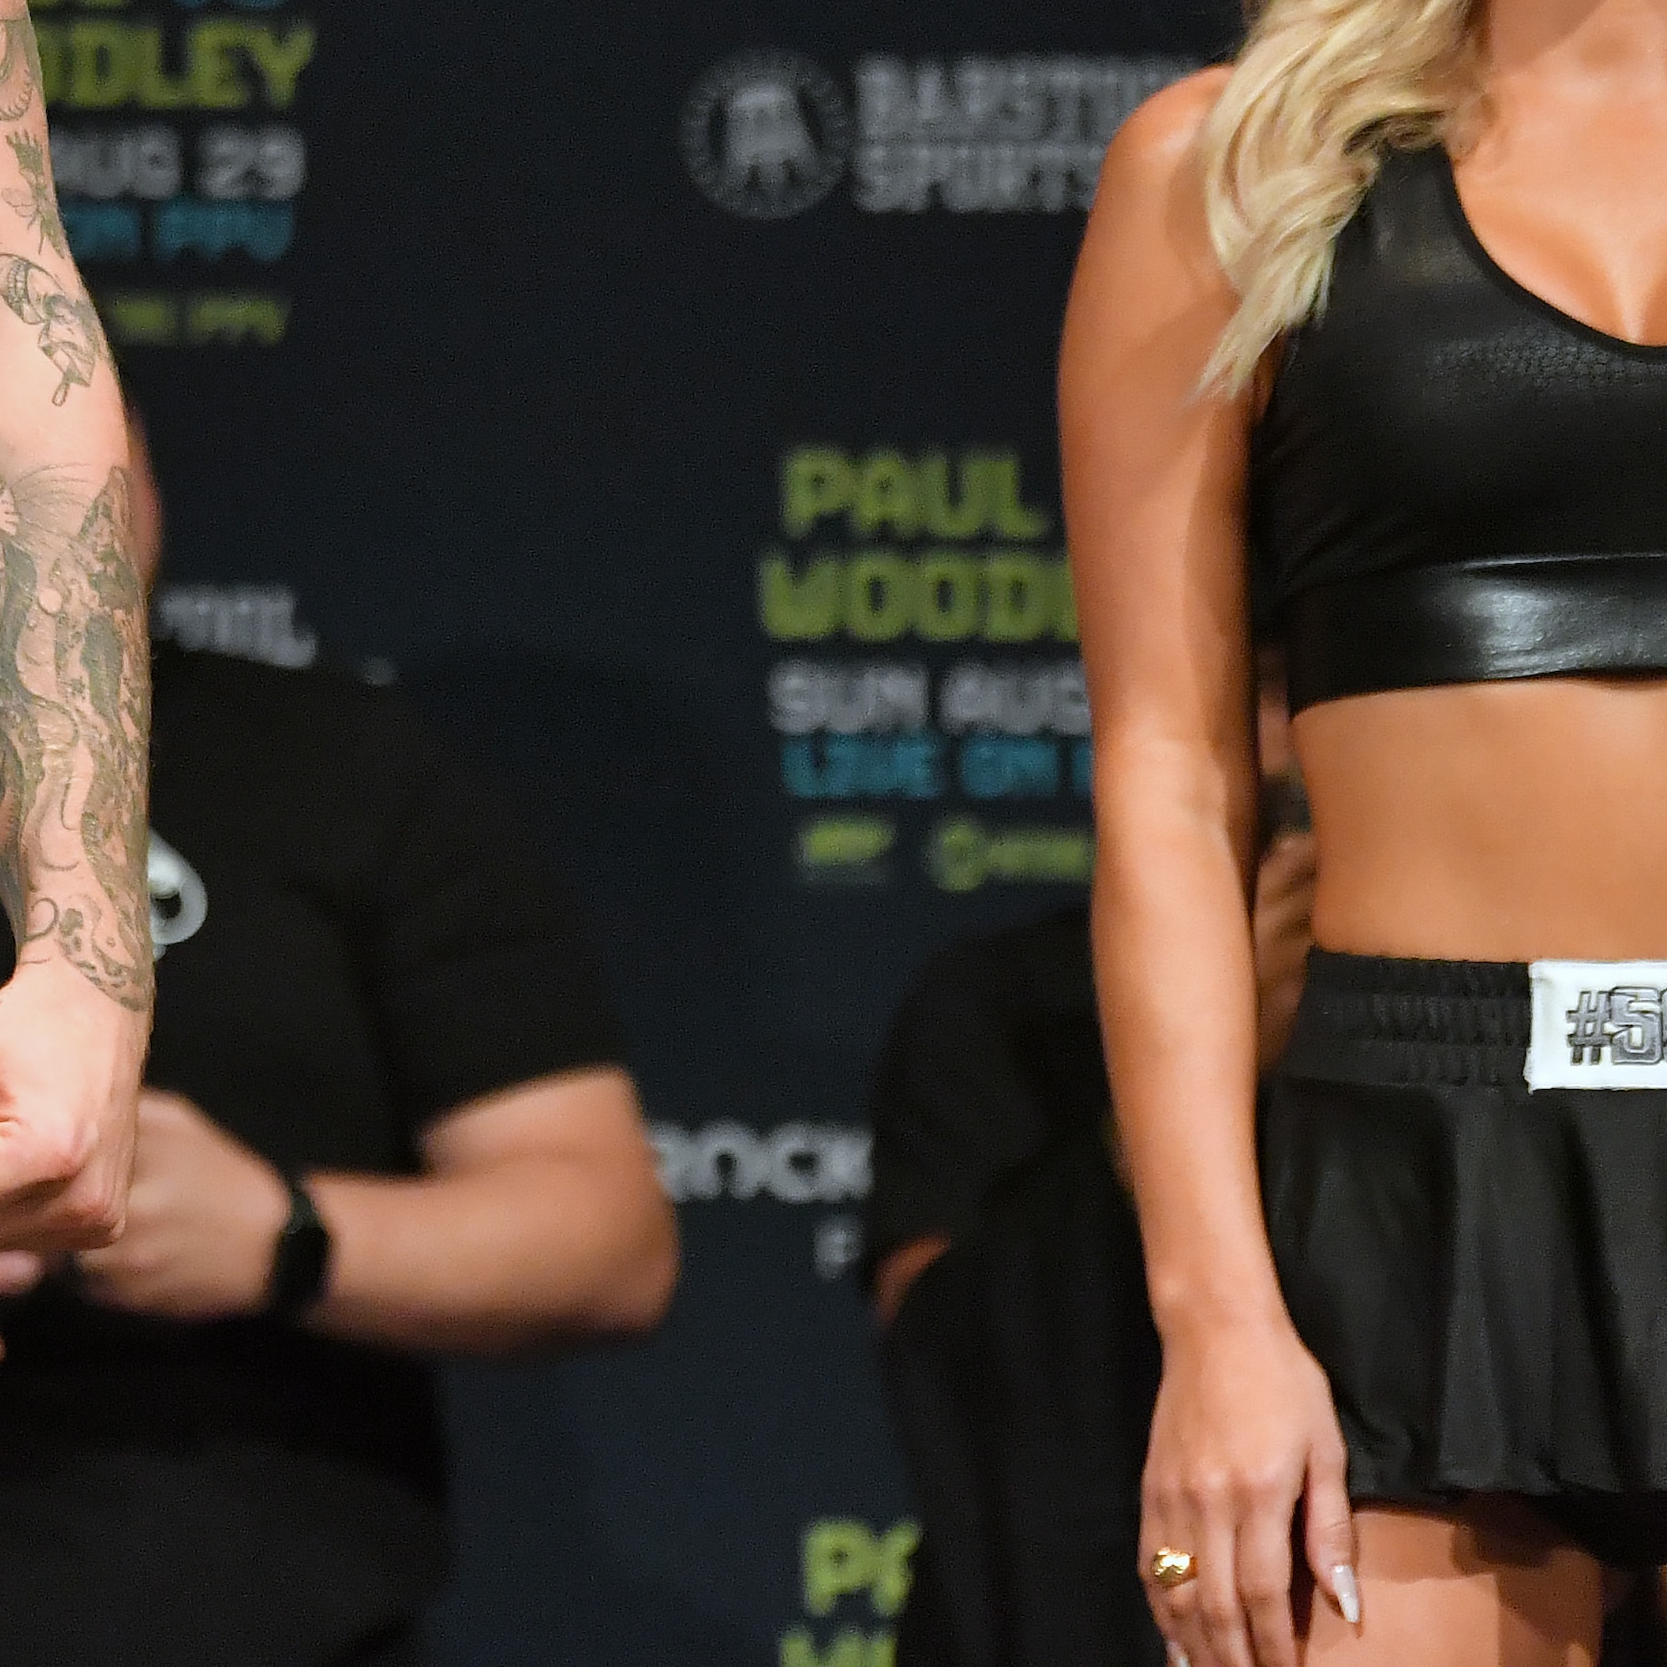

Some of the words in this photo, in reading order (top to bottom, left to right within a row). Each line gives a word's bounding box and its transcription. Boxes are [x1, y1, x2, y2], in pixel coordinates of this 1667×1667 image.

[196, 122, 307, 201] 29
[781, 443, 1049, 539] PAUL
[767, 658, 930, 735] SUN
[1566, 986, 1667, 1065] #5
